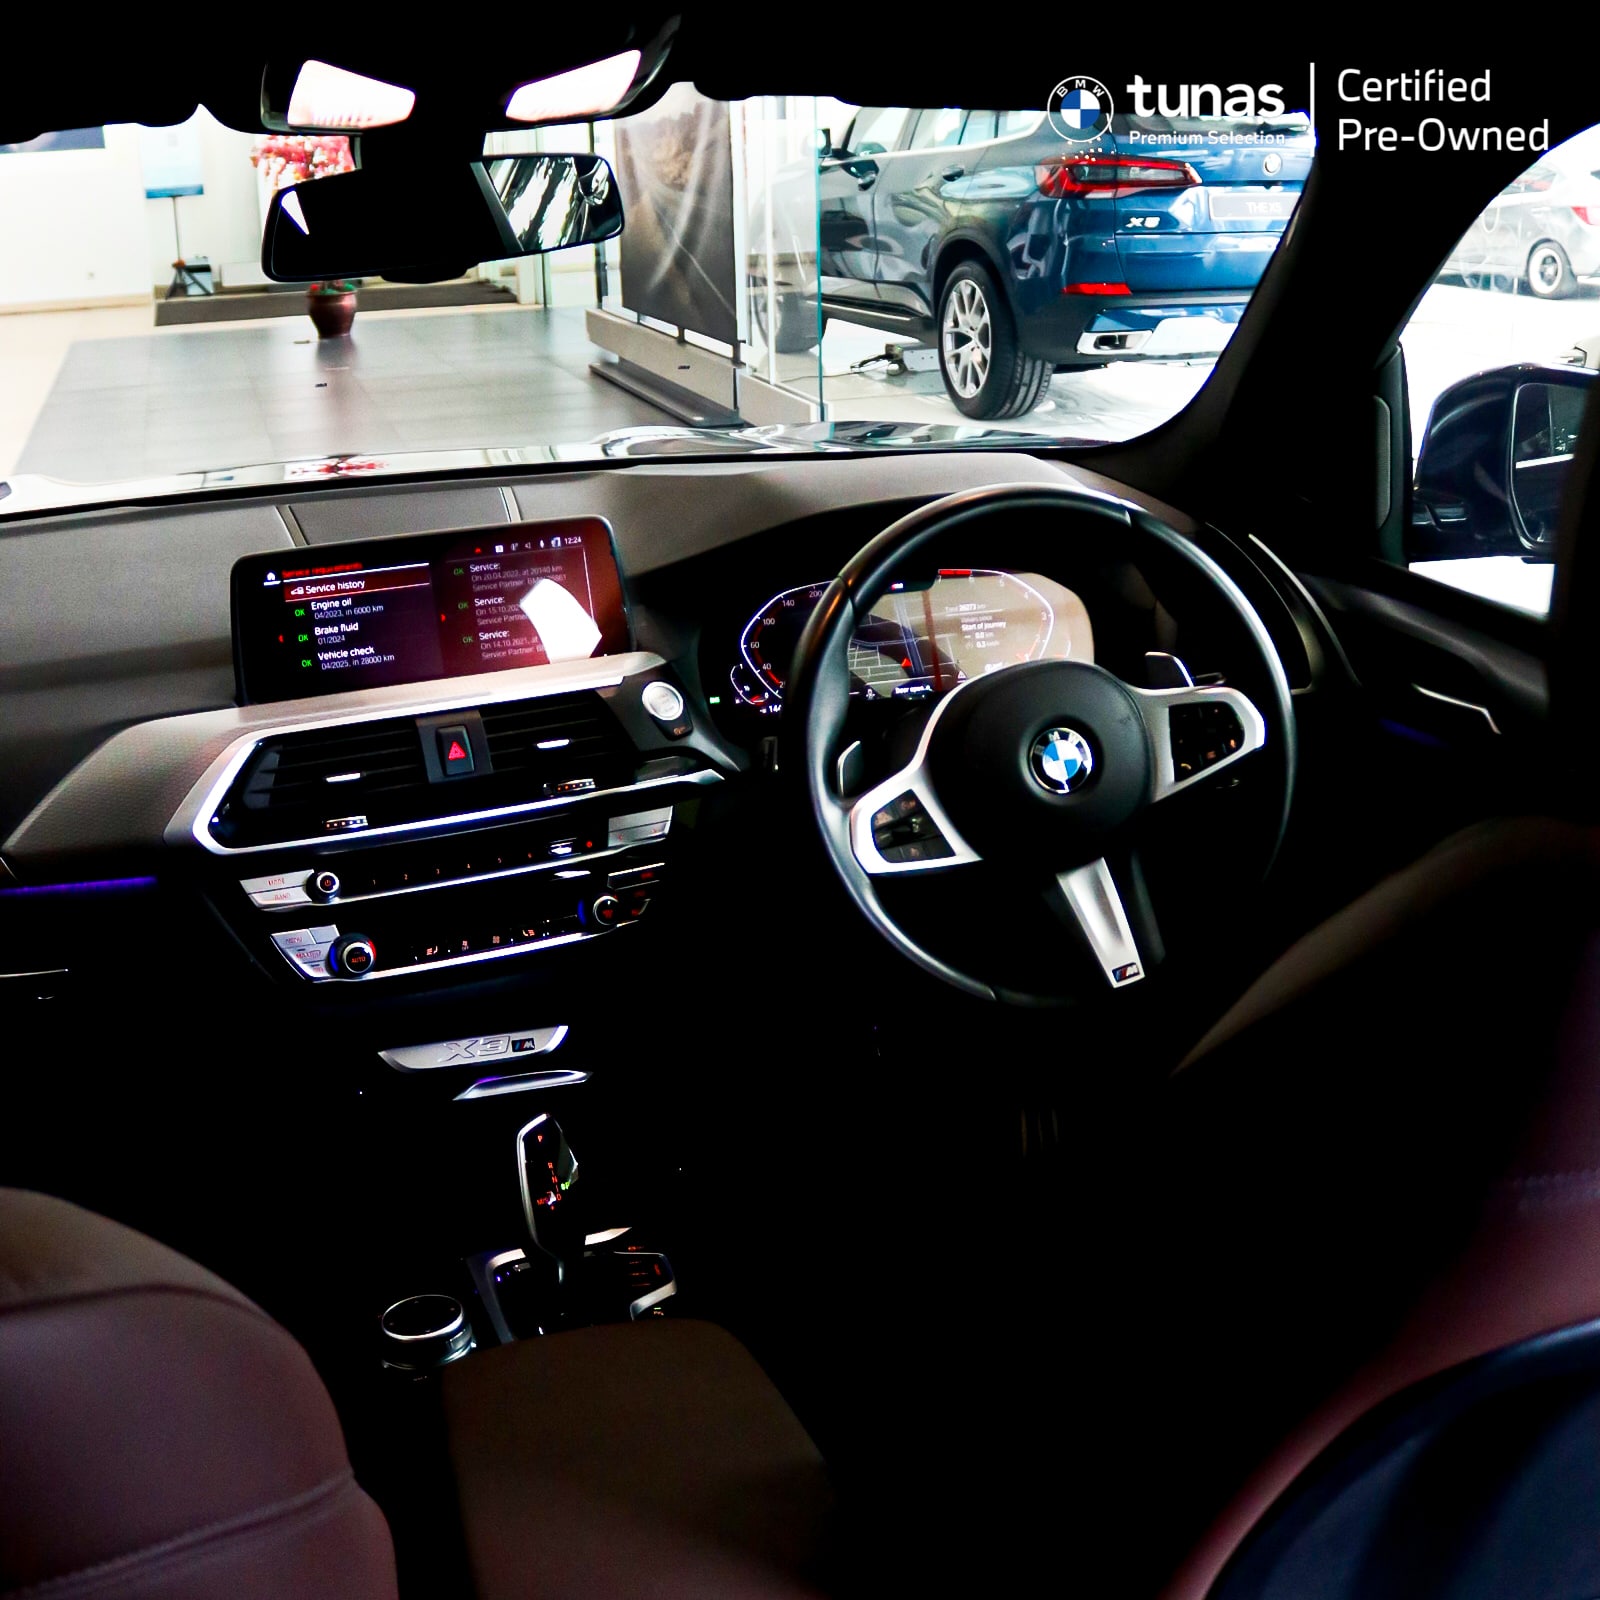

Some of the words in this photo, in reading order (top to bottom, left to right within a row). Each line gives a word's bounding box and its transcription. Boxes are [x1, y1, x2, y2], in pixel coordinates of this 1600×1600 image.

[564, 536, 582, 545] 12:24
[305, 583, 336, 594] Service
[337, 580, 366, 590] history
[311, 600, 340, 611] Engine
[341, 598, 352, 606] oil
[458, 602, 469, 610] OK
[474, 596, 505, 606] Service:
[295, 609, 305, 617] OK
[346, 607, 352, 615] in
[354, 606, 372, 615] 6000
[373, 604, 384, 612] km
[314, 625, 338, 636] Brake
[341, 622, 359, 632] fluid
[298, 634, 309, 642] OK
[318, 635, 346, 645] 01/2024
[479, 630, 510, 641] Service:
[750, 641, 759, 649] 60
[318, 649, 349, 661] Vehicle
[350, 646, 375, 656] check
[302, 659, 312, 667] OK
[353, 657, 359, 666] in
[361, 655, 382, 665] 28000
[383, 653, 395, 662] km
[437, 1036, 510, 1061] X3
